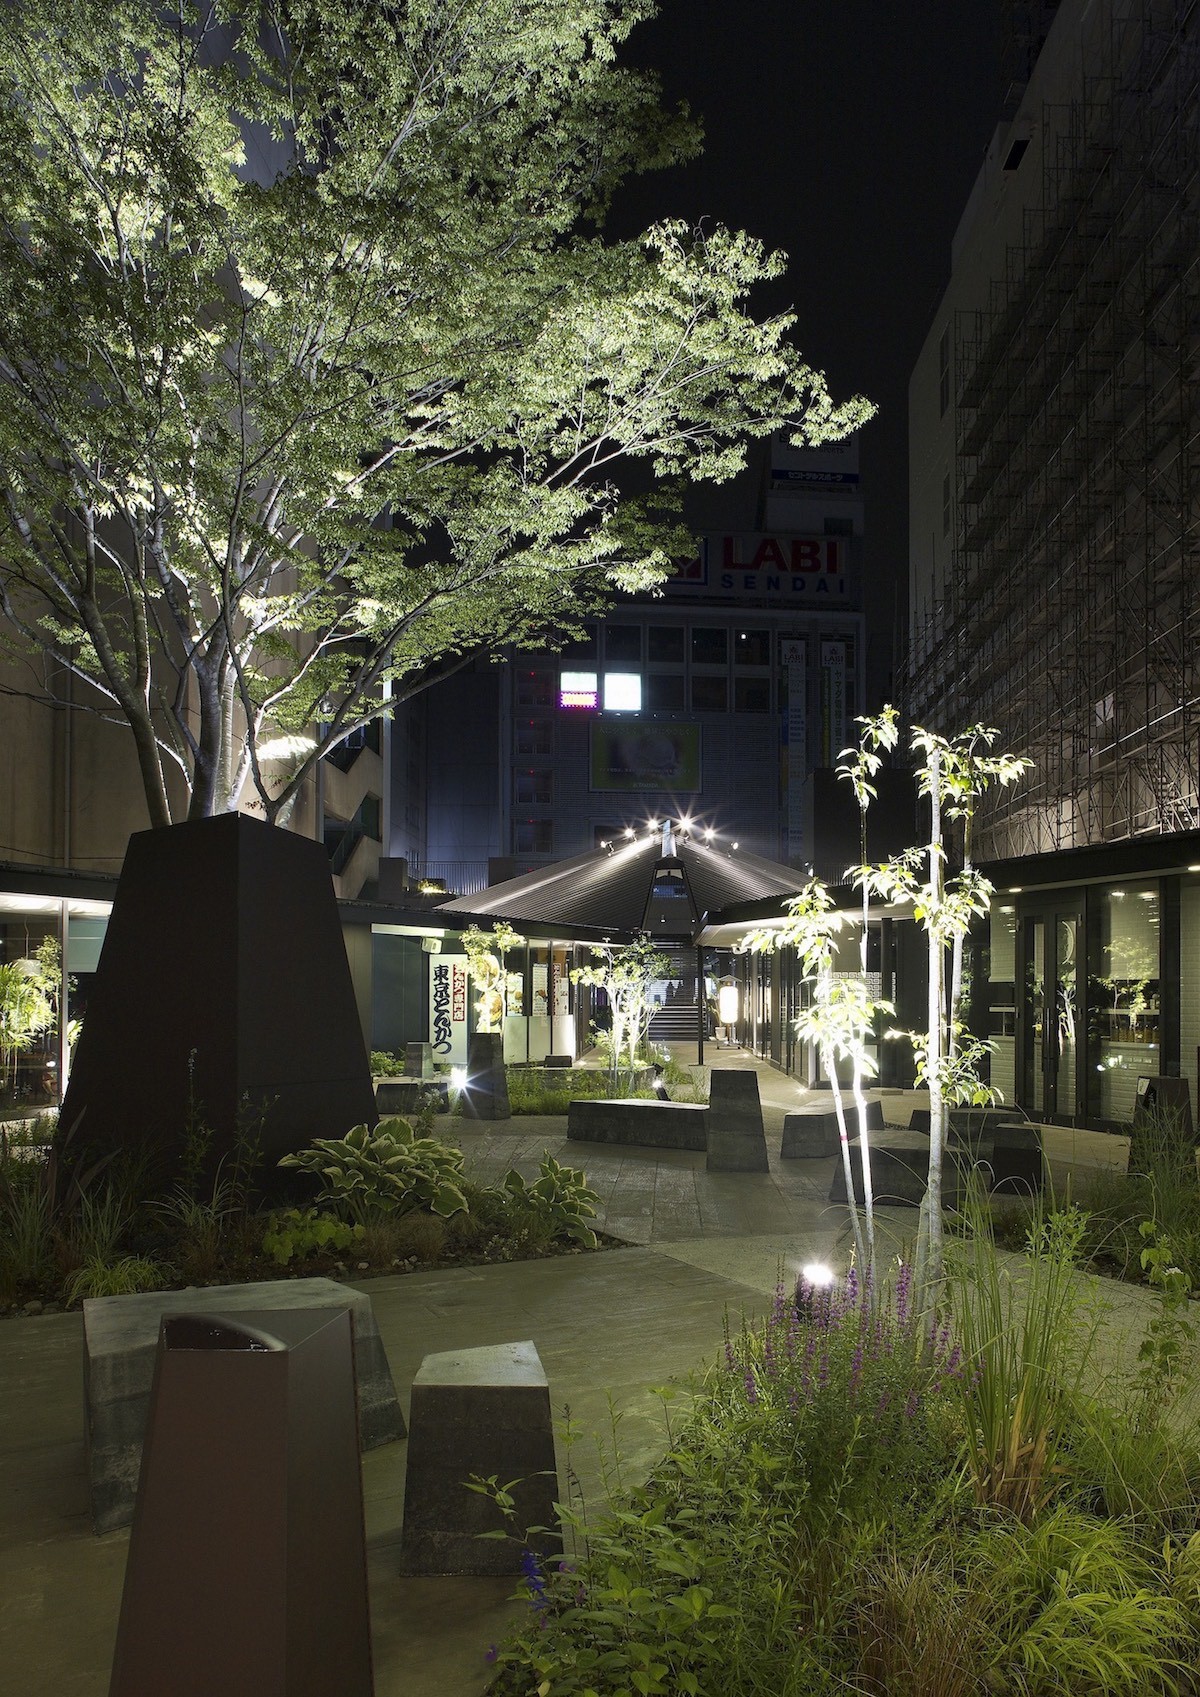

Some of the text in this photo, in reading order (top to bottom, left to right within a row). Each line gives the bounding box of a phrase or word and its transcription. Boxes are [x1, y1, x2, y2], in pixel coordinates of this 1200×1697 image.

[722, 537, 841, 574] LABI
[721, 574, 844, 594] SENDAI
[432, 964, 453, 1055] 東京とんかつ
